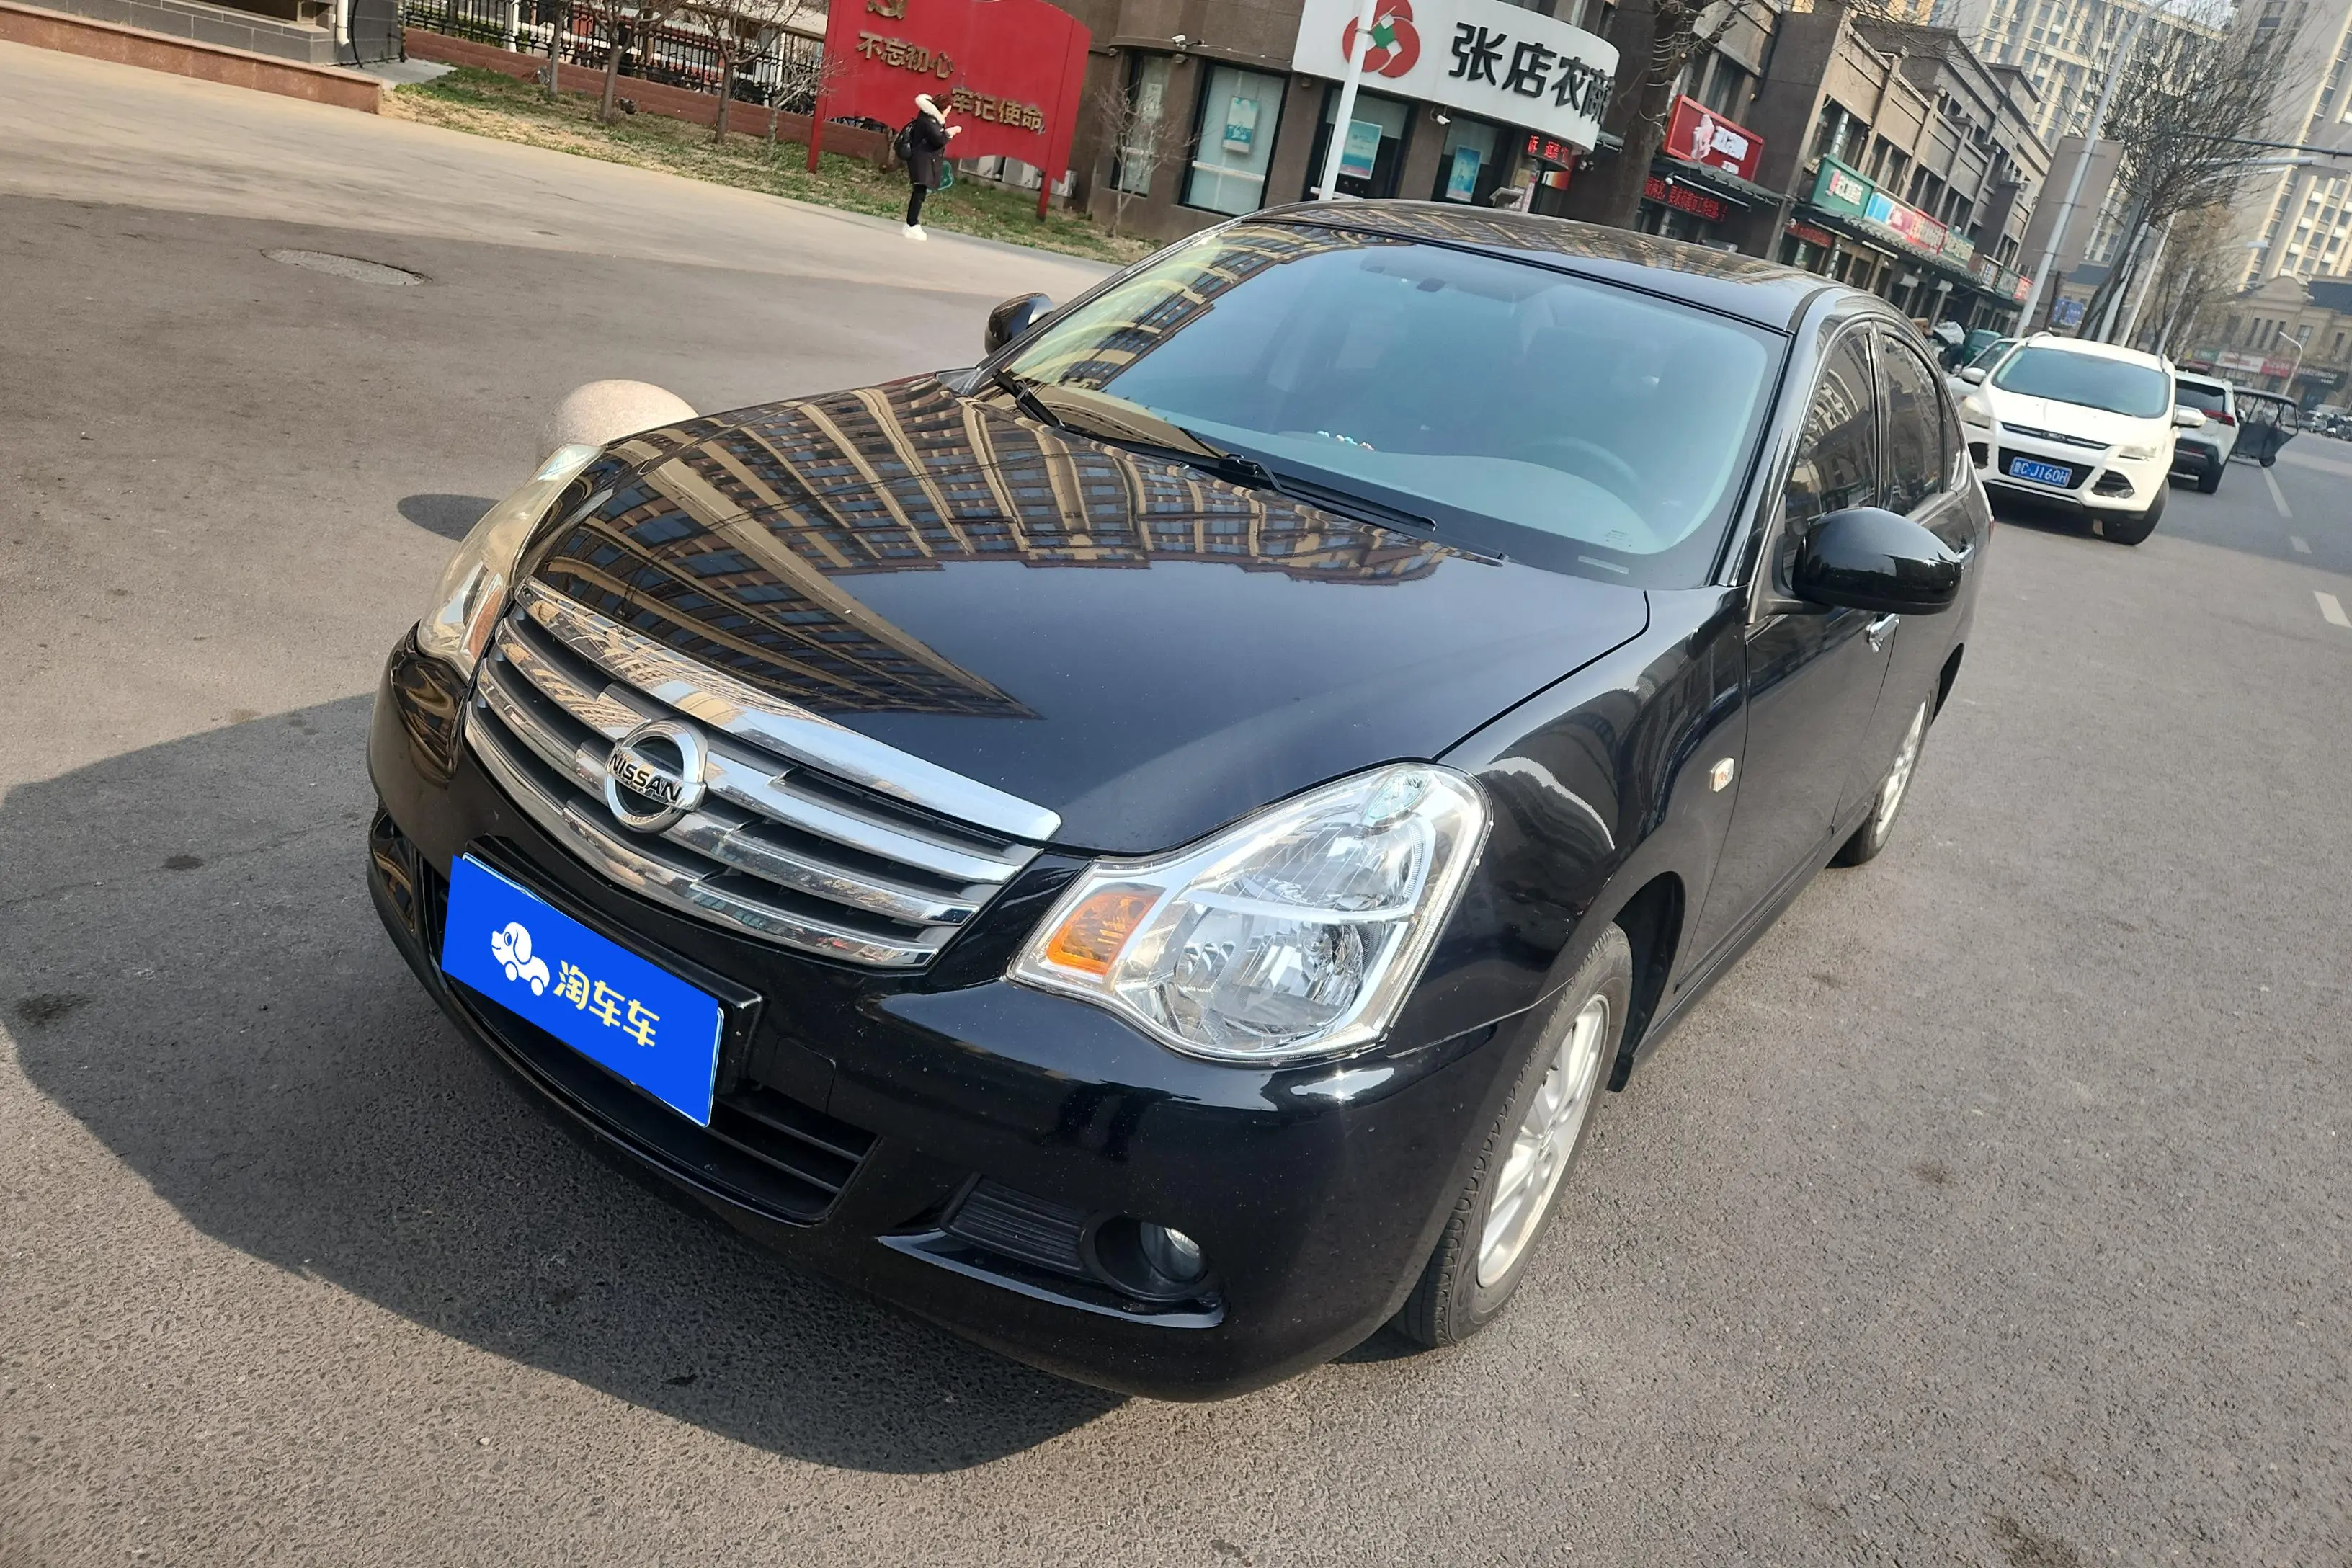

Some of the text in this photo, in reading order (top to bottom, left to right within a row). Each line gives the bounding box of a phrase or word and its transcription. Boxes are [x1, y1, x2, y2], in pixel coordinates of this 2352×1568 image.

[856, 31, 954, 79] 不忘初心
[1448, 22, 1615, 126] 张店农商
[951, 86, 1045, 131] 牢记使命
[608, 752, 683, 802] NISSAN
